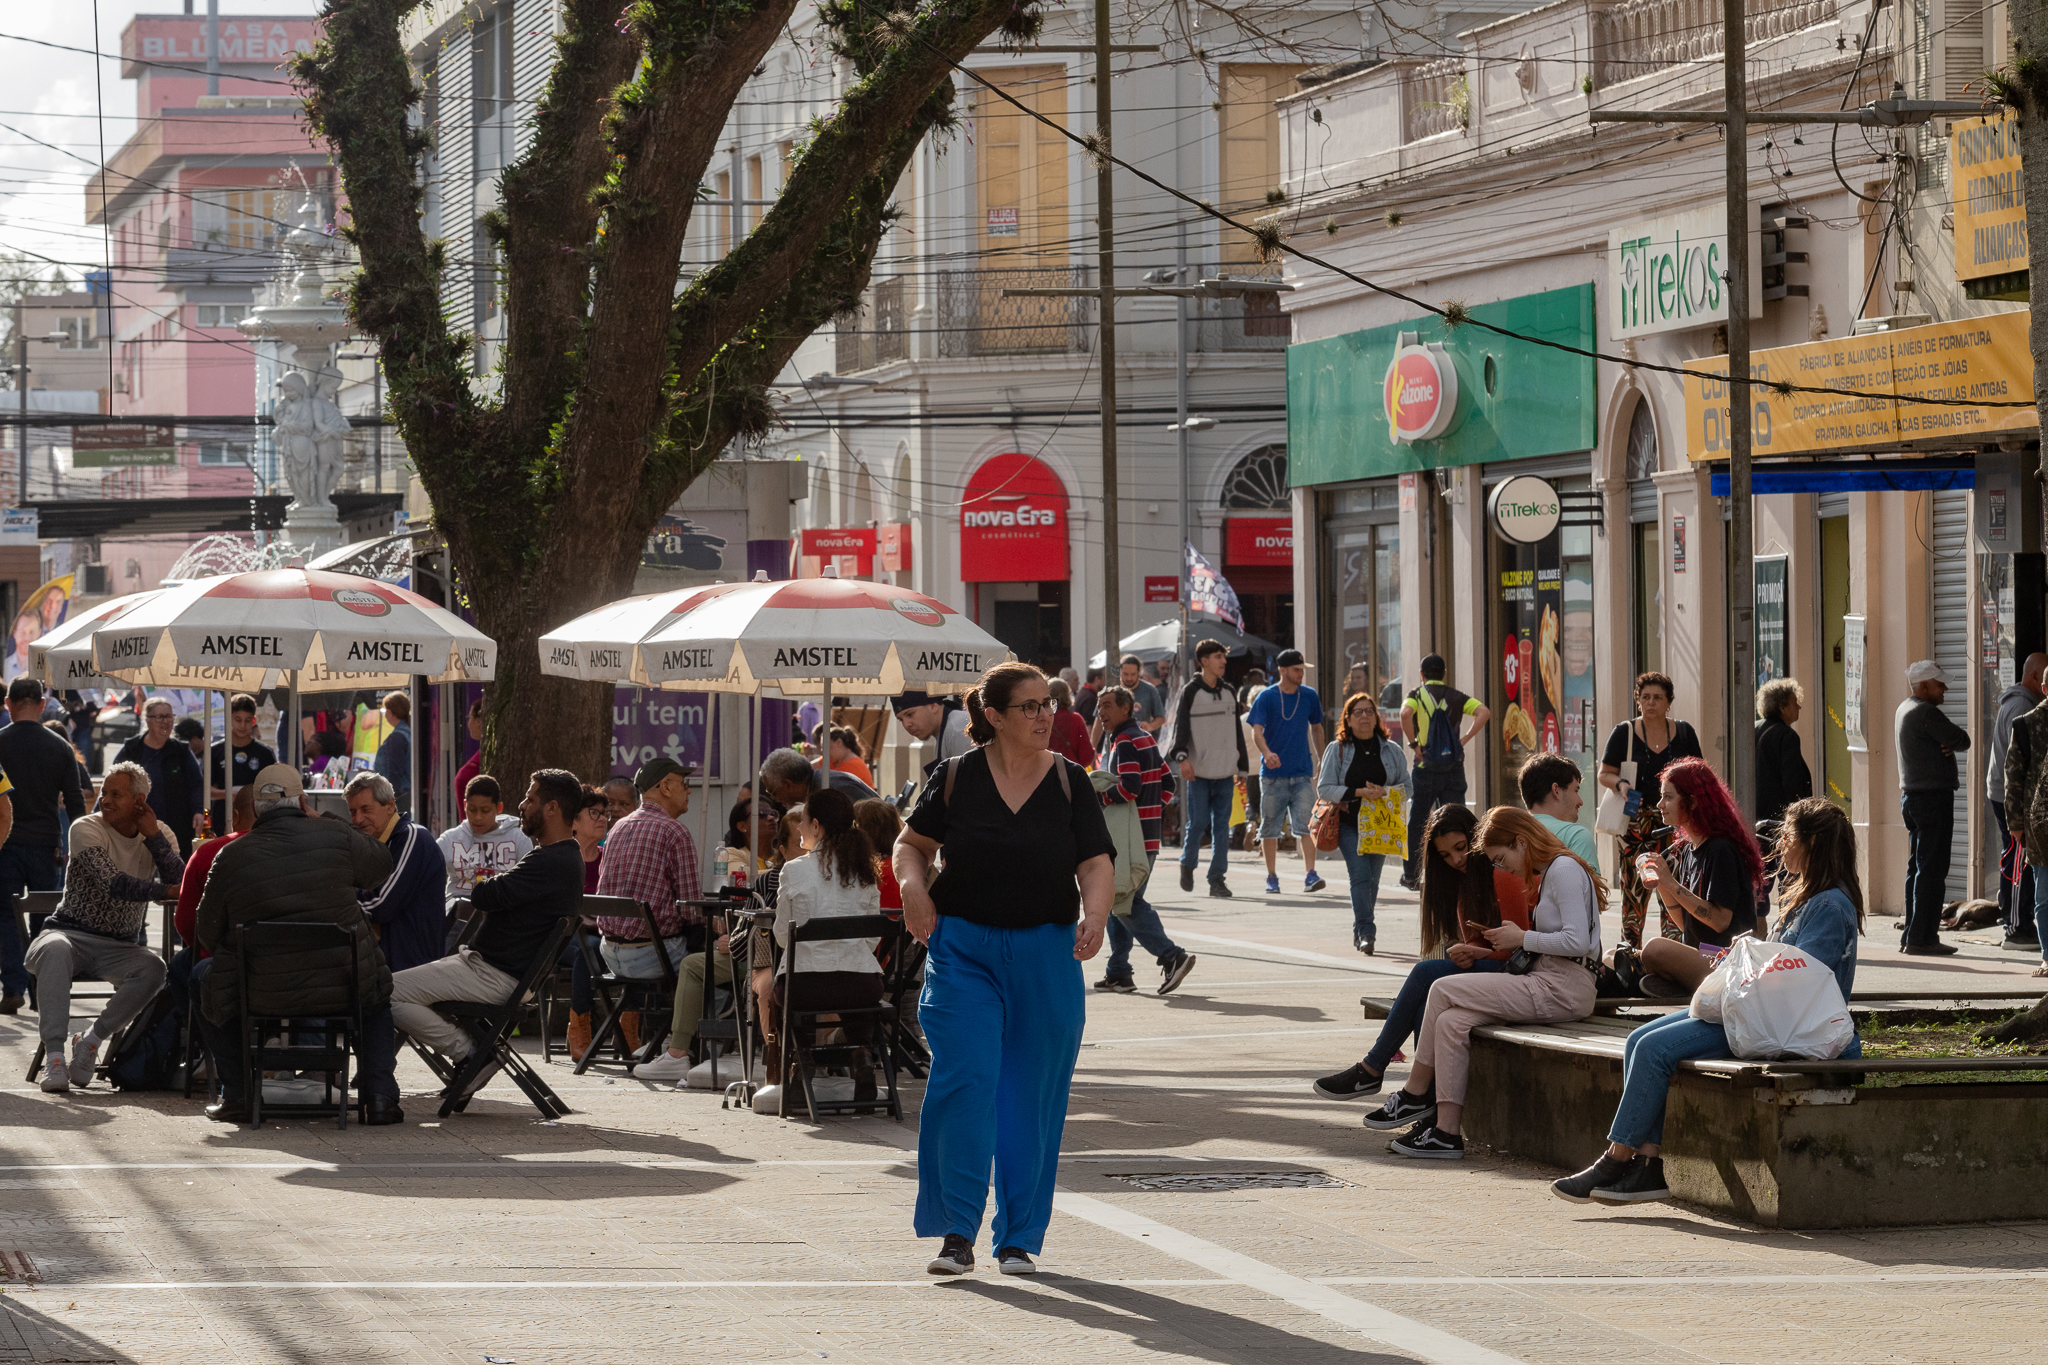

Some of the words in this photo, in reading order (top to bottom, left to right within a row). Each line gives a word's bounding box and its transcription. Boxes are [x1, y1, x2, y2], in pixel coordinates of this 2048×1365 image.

[1958, 121, 2005, 168] COMPRO
[1967, 172, 2014, 217] FABRICA
[1974, 219, 2027, 268] ALIANÇAS
[1637, 229, 1720, 325] Trekos
[1834, 352, 1845, 367] DE
[1847, 345, 1888, 367] ALIANÇAS
[1890, 344, 1895, 359] E
[1897, 338, 1923, 358] ANÉIS
[1925, 338, 1937, 354] DE
[1938, 330, 1993, 352] FORMATURA
[1867, 373, 1874, 388] E
[1928, 363, 1940, 379] DE
[1942, 357, 1969, 377] JÓIAS
[1793, 403, 1827, 421] COMPRO
[1828, 396, 1887, 417] ANTIGUIDADES
[1969, 380, 2008, 399] ANTIGAS
[1703, 401, 1772, 452] OUO
[1815, 425, 1854, 442] PRATARIA
[1855, 419, 1890, 438] GAÚCHA
[1891, 416, 1920, 434] FACAS
[1921, 410, 1962, 431] ESPADAS
[964, 505, 1056, 528] novaEra
[1510, 502, 1558, 517] Trekos
[816, 537, 864, 547] novaEra
[111, 636, 149, 659] AMSTEL
[200, 635, 283, 657] AMSTEL
[346, 641, 424, 664] AMSTEL
[773, 647, 858, 668] AMSTEL
[464, 648, 489, 669] AMSTEL
[589, 650, 622, 669] AMSTEL
[662, 649, 713, 671] AMSTEL
[916, 651, 982, 674] AMSTEL
[646, 700, 704, 726] tem
